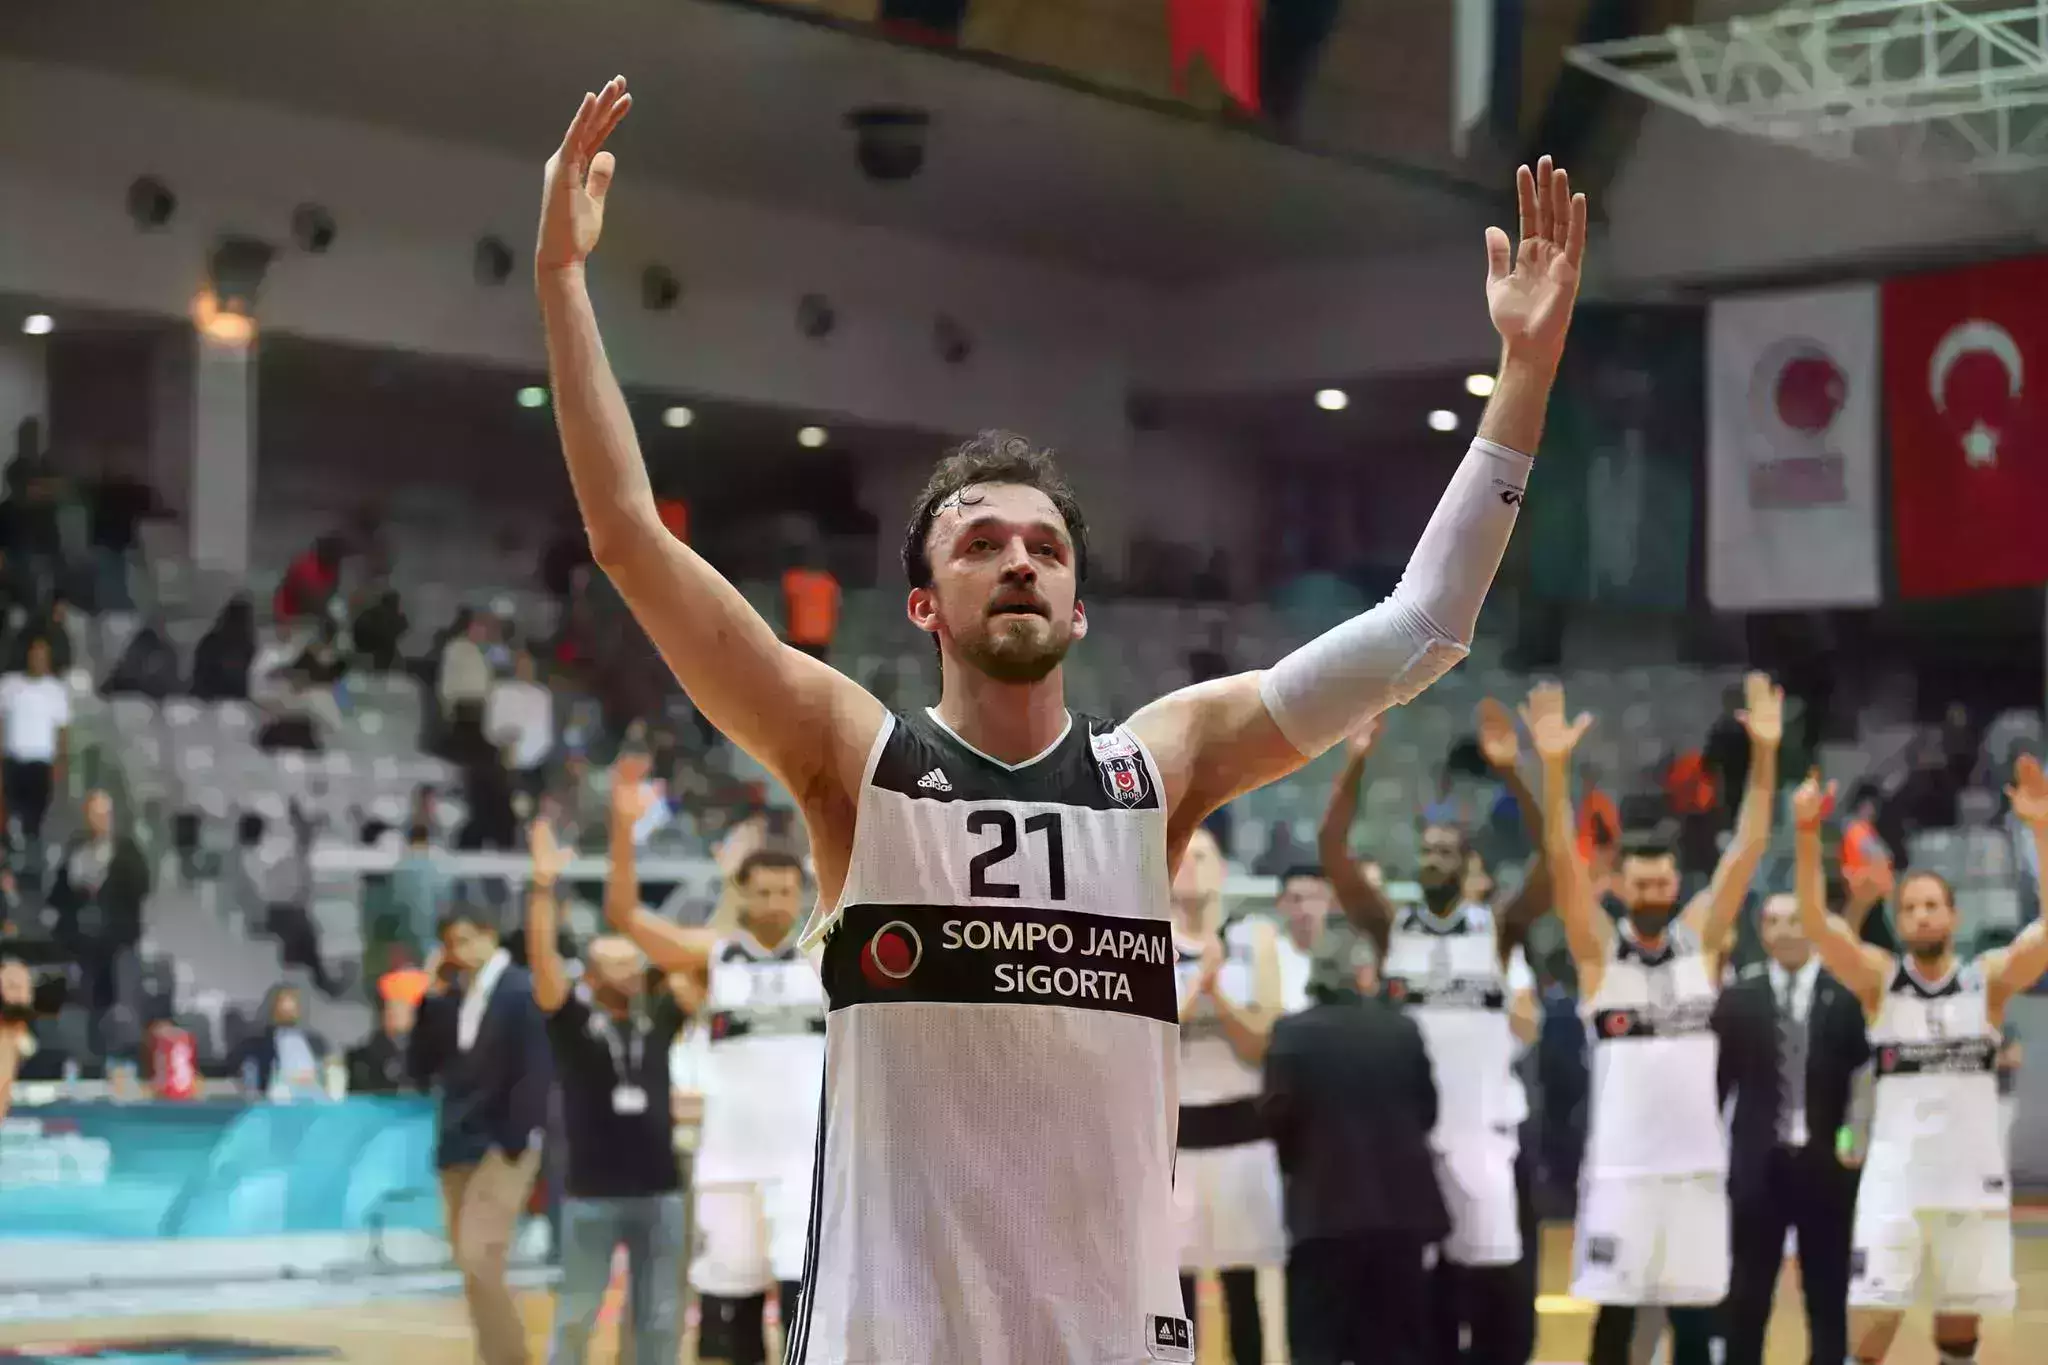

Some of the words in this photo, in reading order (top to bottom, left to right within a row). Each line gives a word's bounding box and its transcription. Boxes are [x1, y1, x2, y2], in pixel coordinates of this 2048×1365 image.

[1106, 760, 1135, 772] BJK
[917, 779, 953, 792] adidas
[966, 809, 1066, 901] 21
[941, 919, 1074, 951] SOMPO
[1080, 926, 1167, 965] JAPAN
